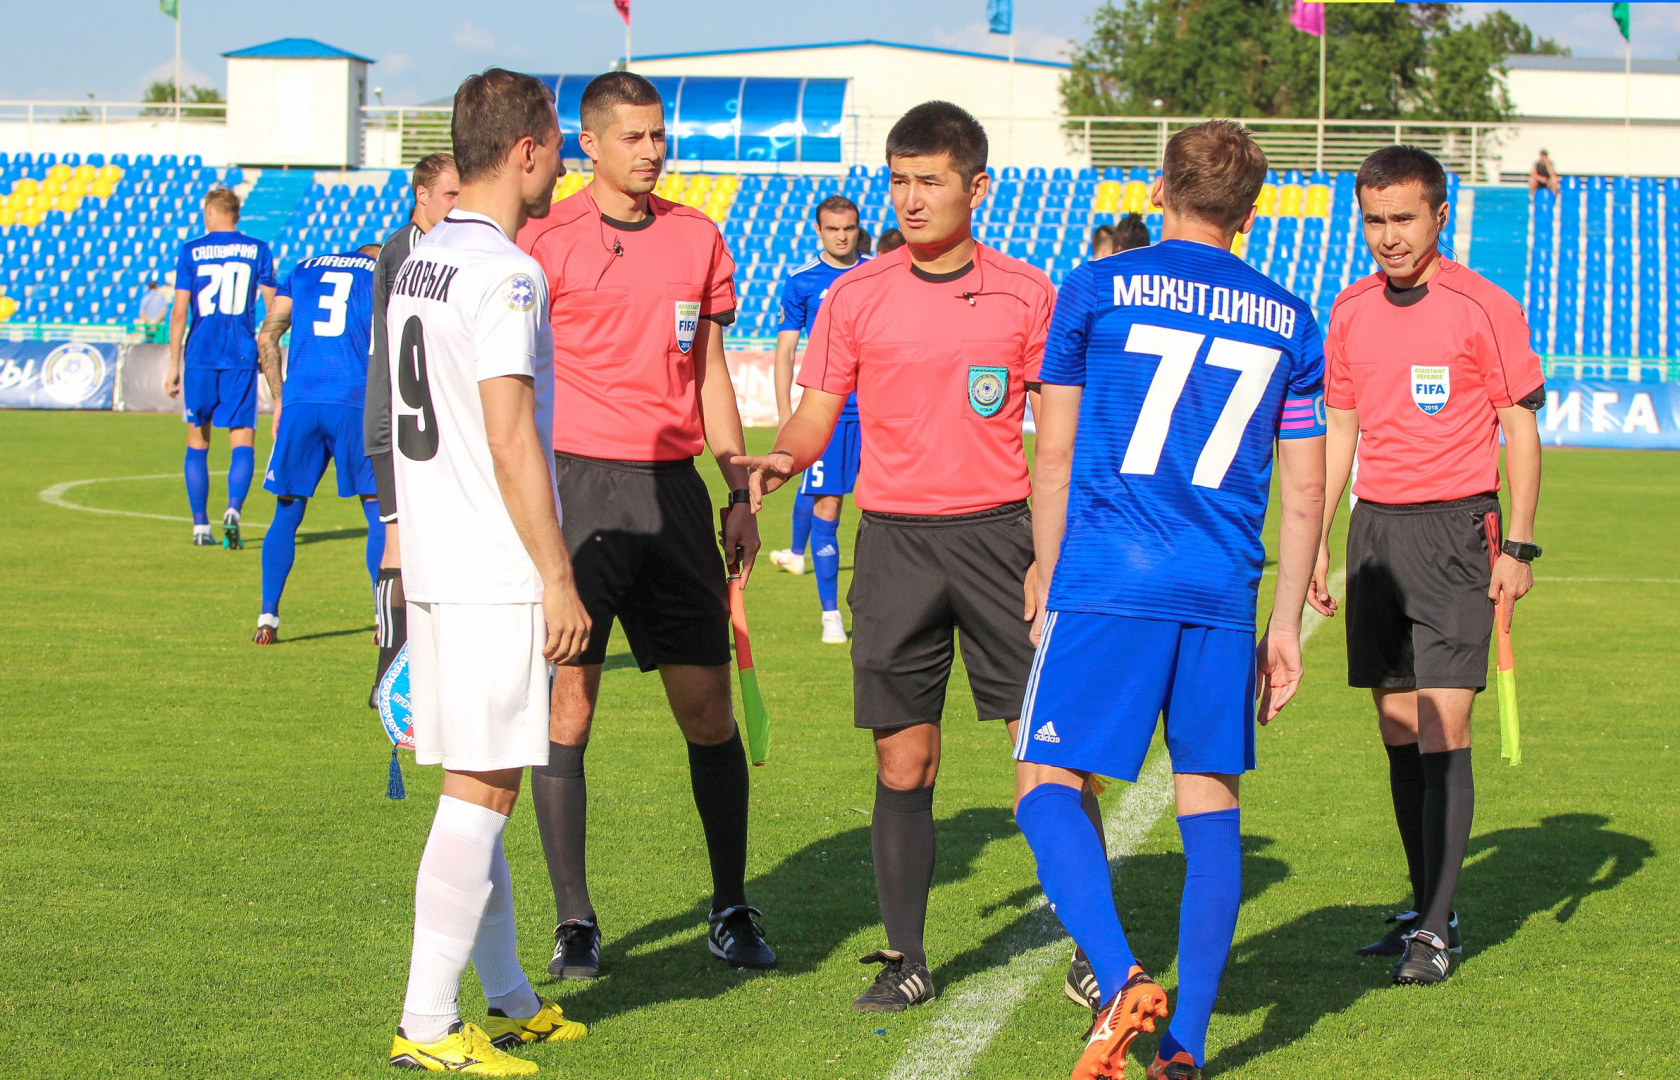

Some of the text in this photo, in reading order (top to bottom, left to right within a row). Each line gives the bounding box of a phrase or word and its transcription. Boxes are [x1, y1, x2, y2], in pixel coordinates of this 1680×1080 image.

[197, 262, 251, 317] 20
[392, 260, 459, 303] КОРЫХ
[313, 271, 353, 337] 3
[679, 320, 696, 331] FIFA
[1113, 274, 1296, 339] МУХУТДИНОВ
[398, 315, 439, 461] 9
[1119, 323, 1282, 489] 77
[1416, 384, 1445, 394] FIFA
[1546, 391, 1661, 434] ИГА
[811, 460, 824, 487] 5
[1034, 733, 1061, 743] adidas
